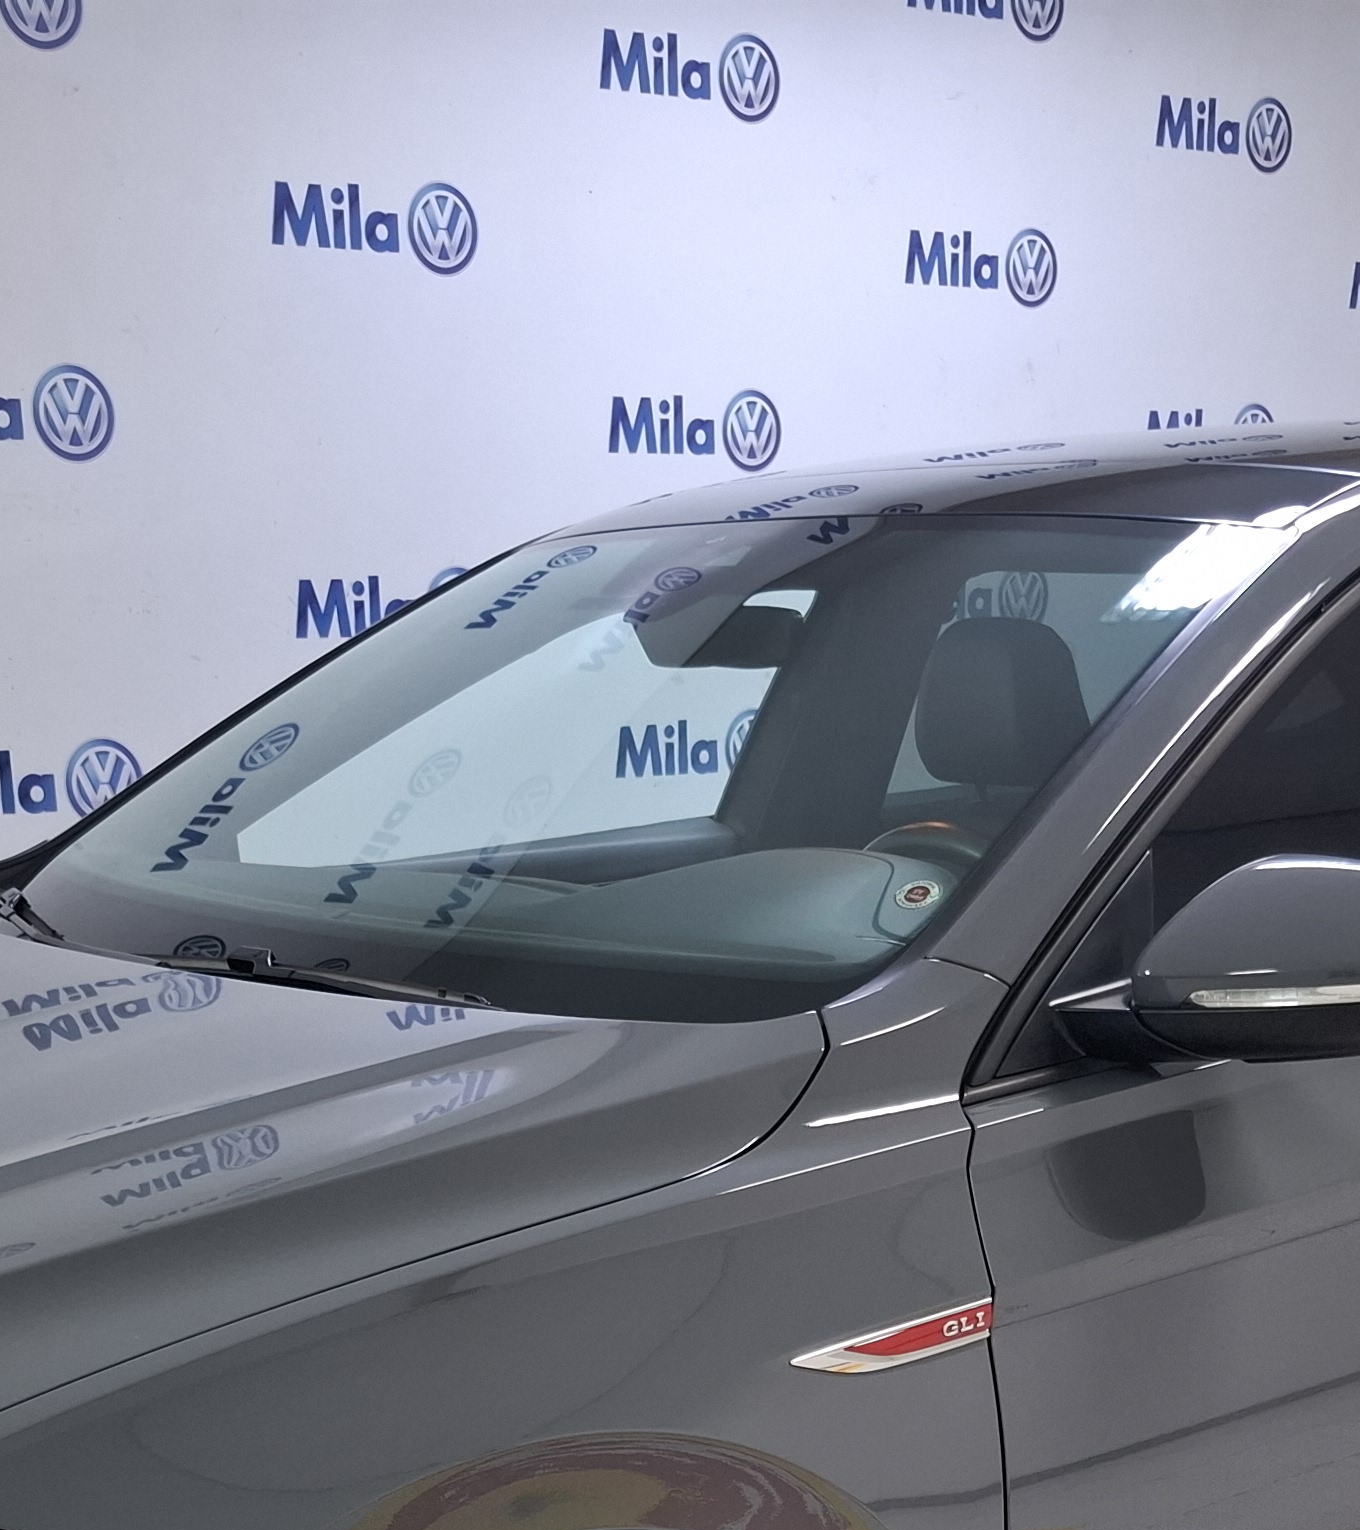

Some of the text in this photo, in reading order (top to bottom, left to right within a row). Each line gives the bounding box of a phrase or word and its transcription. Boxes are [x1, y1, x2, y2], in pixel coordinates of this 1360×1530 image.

[600, 28, 711, 100] Mila
[1156, 95, 1240, 155] Mila
[272, 181, 399, 253] Mila
[905, 230, 999, 289] Mila
[607, 394, 716, 456] Mila
[616, 720, 718, 778] Mila
[941, 1311, 986, 1338] GLI
